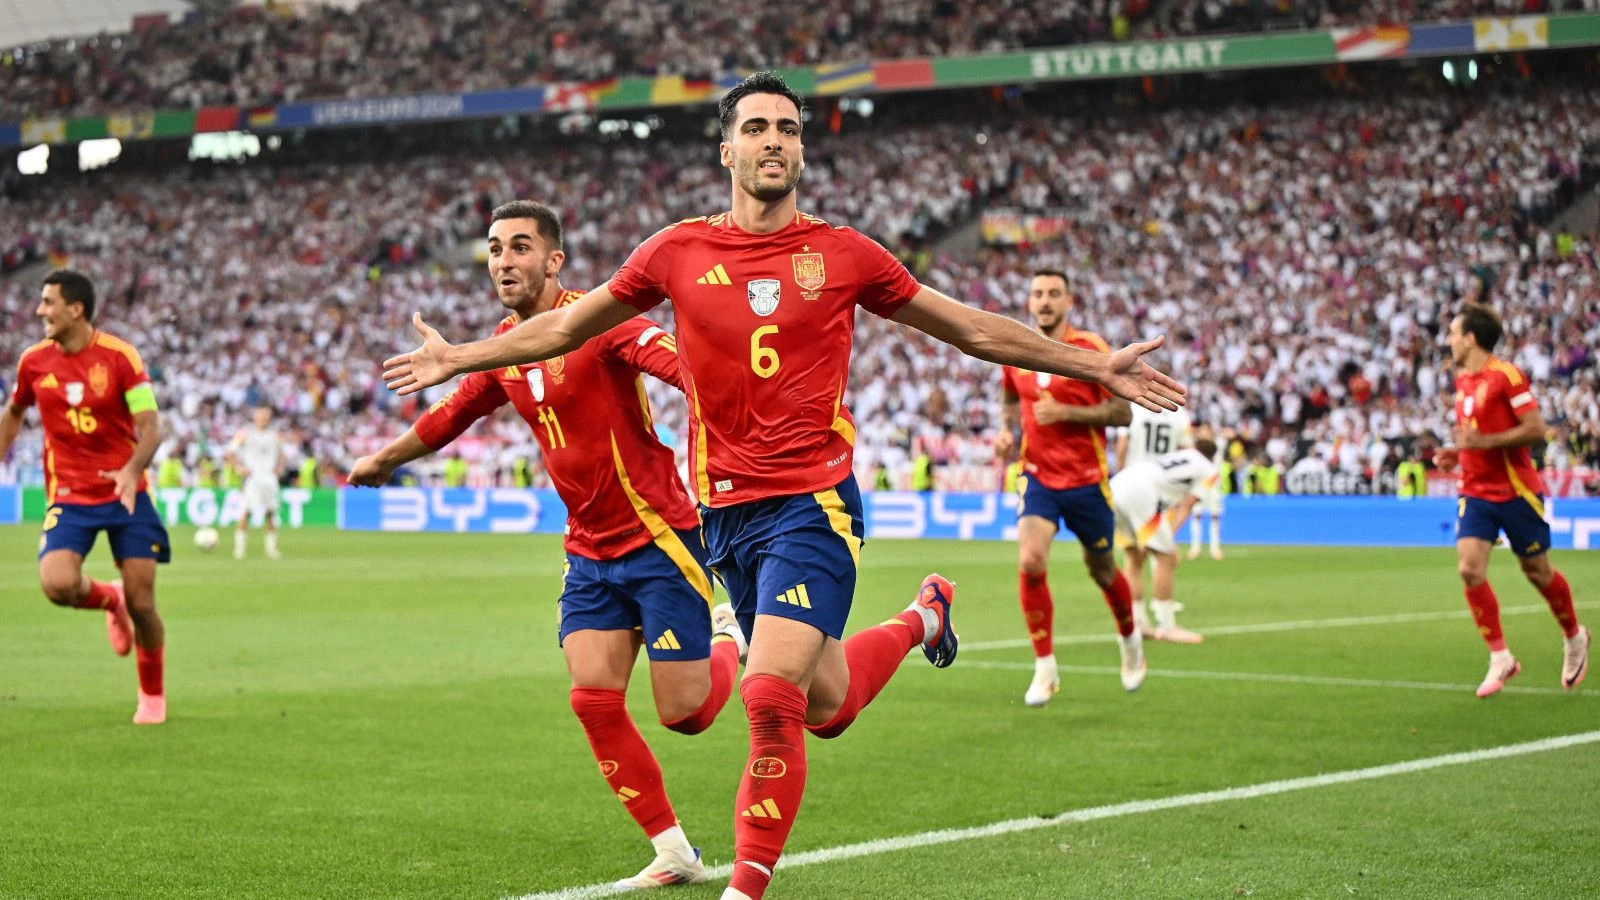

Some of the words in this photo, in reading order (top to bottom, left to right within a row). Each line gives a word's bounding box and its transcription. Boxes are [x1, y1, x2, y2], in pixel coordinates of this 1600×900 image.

[1030, 40, 1226, 78] STUTTGART
[750, 324, 780, 379] 6
[65, 407, 97, 434] 16
[537, 406, 567, 450] 11
[1144, 422, 1171, 455] 16
[380, 489, 542, 533] BYD
